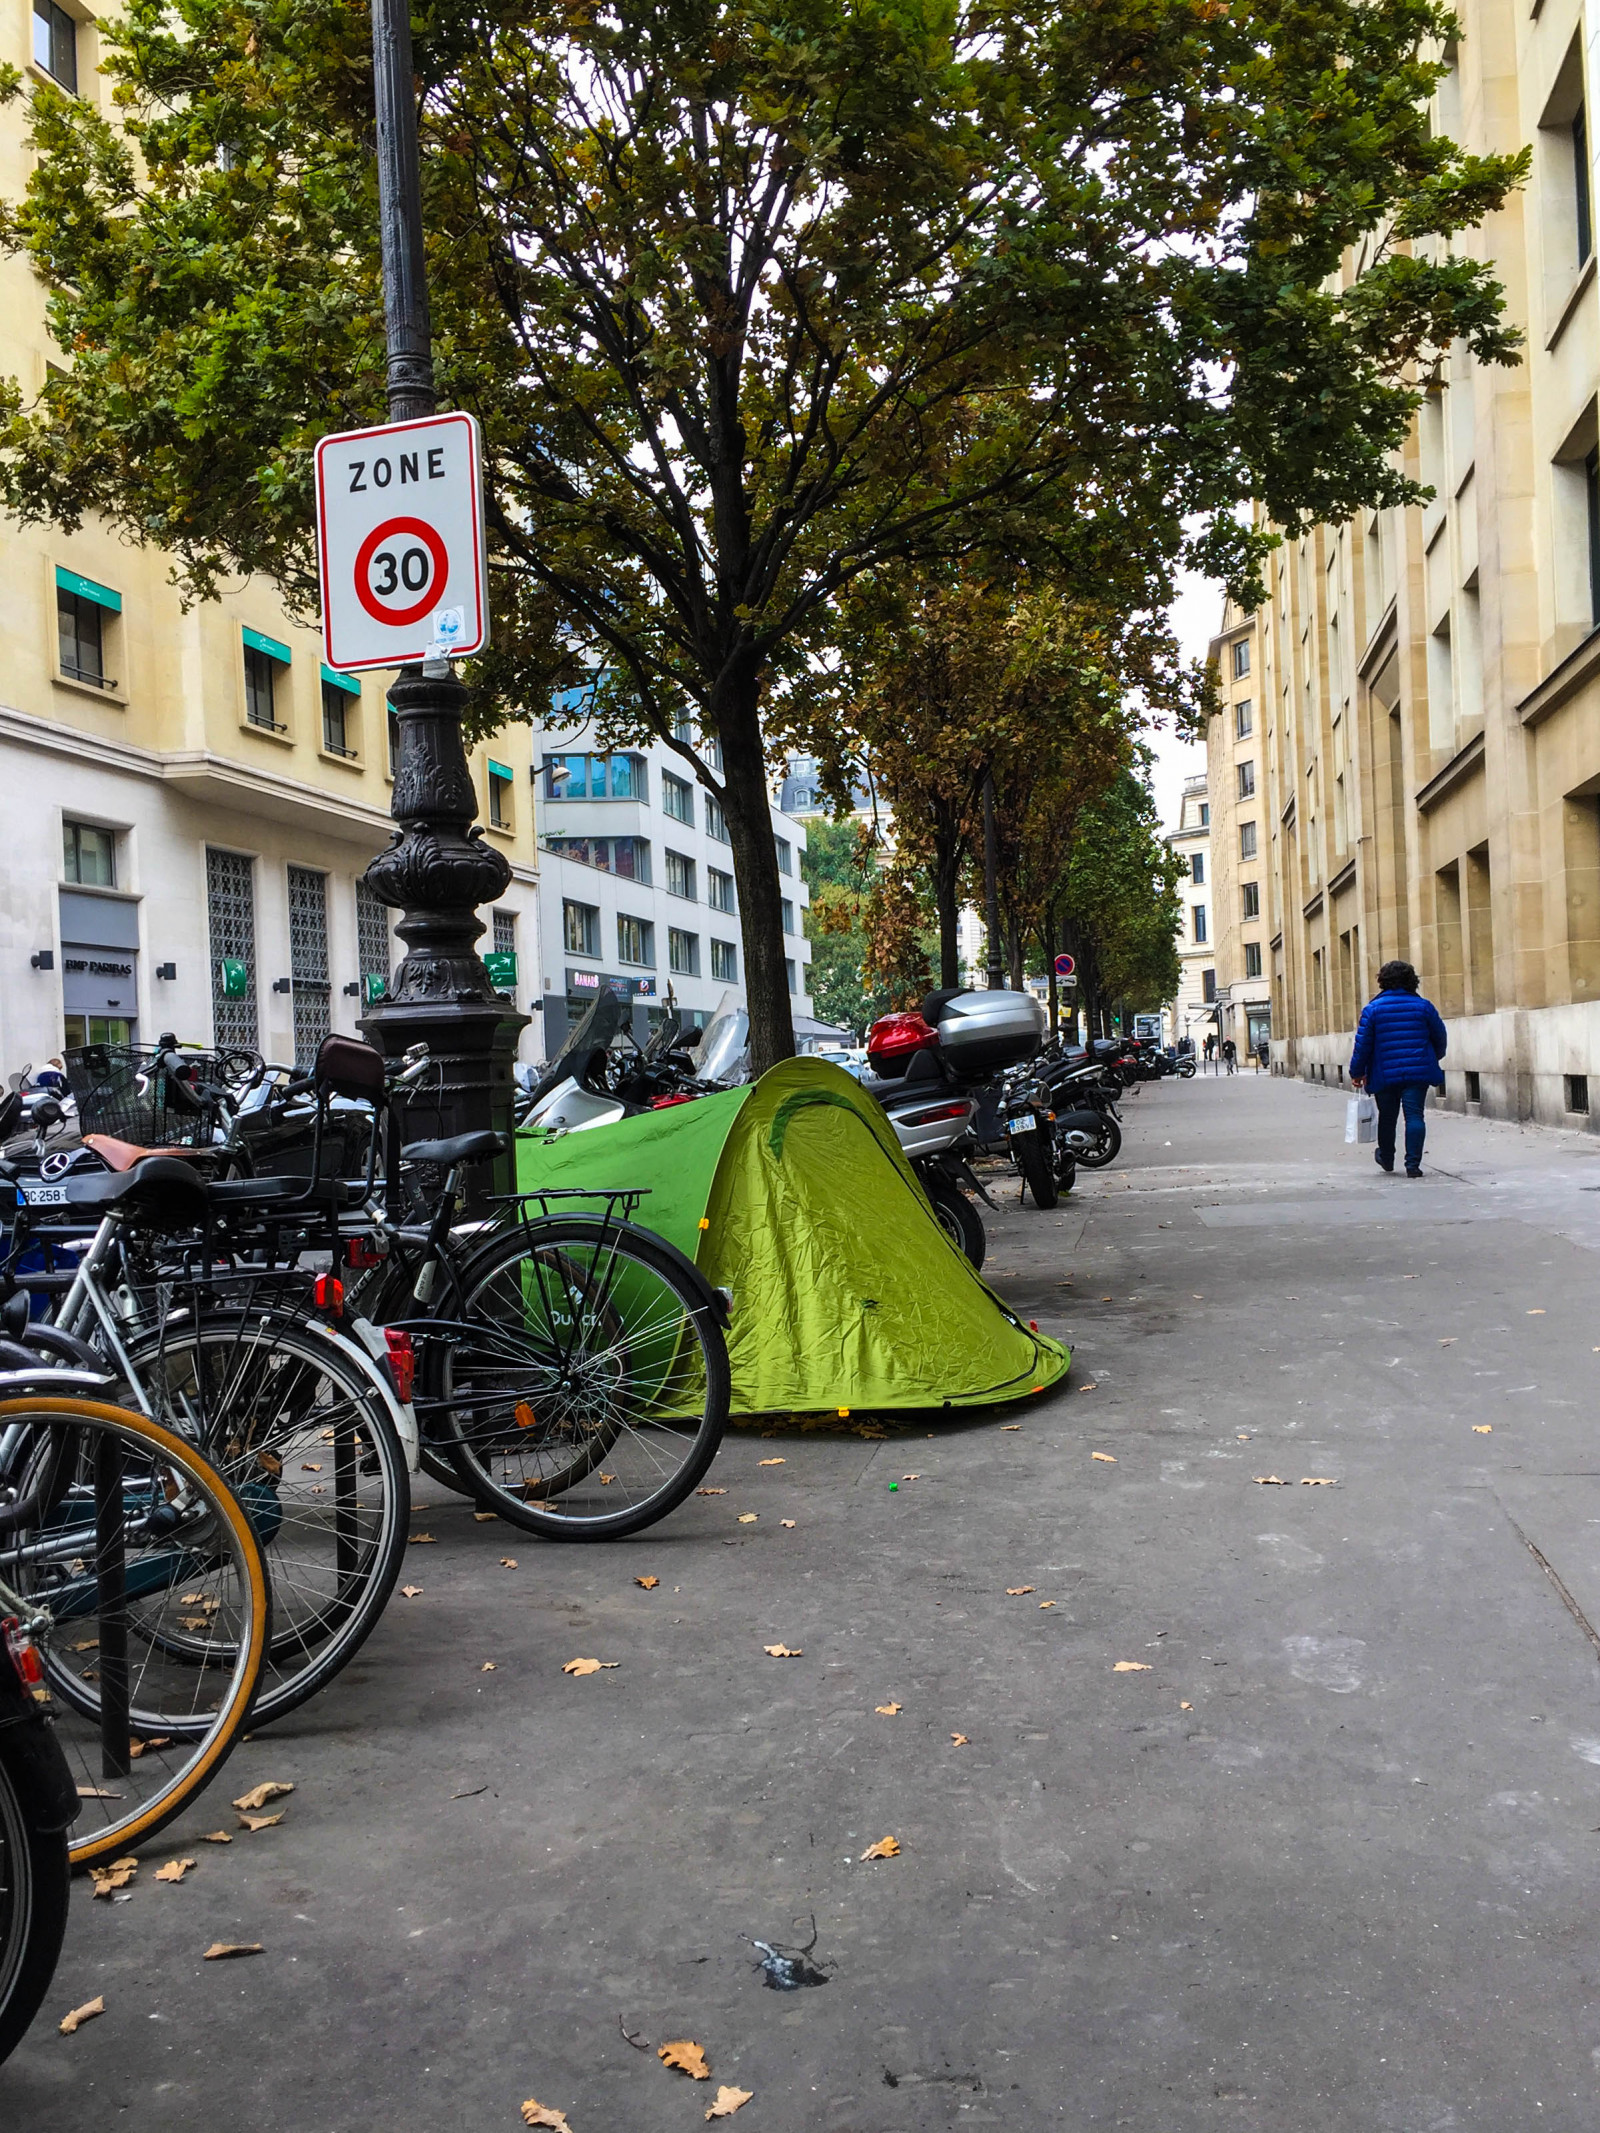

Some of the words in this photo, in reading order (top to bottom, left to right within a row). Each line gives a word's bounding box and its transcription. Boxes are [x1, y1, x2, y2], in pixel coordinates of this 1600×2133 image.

[349, 447, 445, 493] ZONE
[374, 547, 429, 596] 30
[65, 959, 88, 971] BNP
[90, 961, 132, 975] PARIBAS
